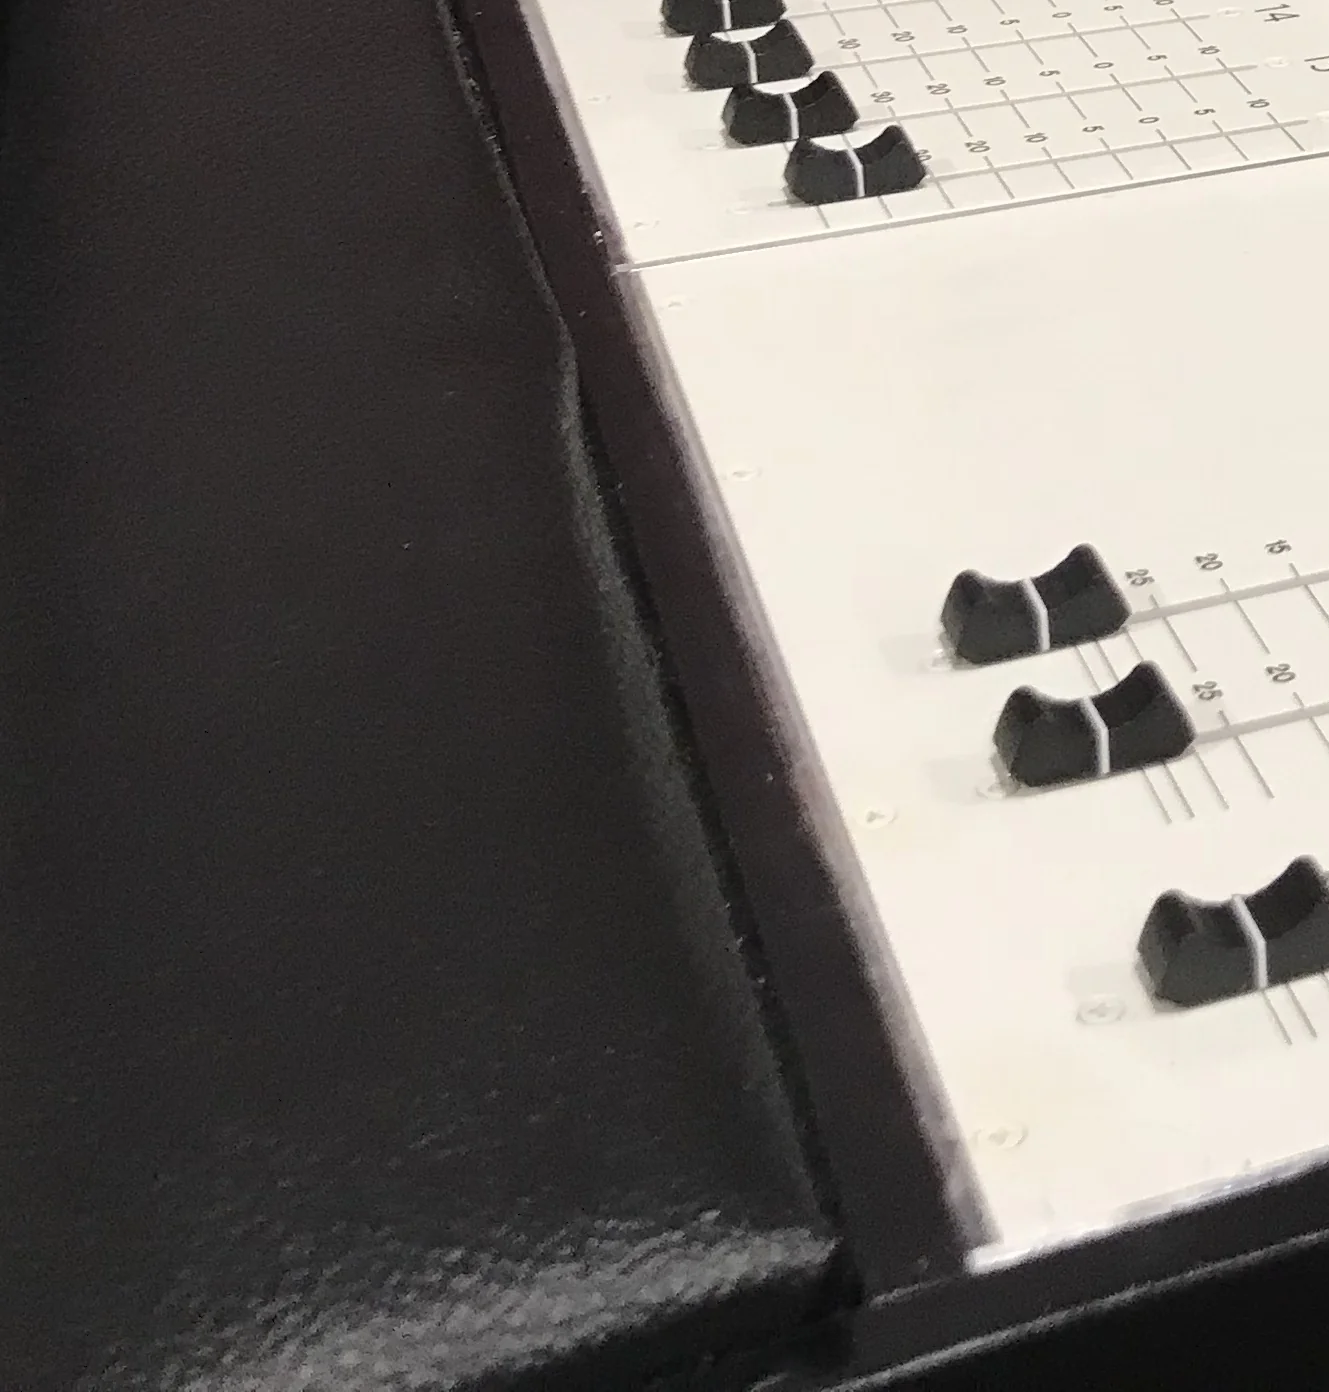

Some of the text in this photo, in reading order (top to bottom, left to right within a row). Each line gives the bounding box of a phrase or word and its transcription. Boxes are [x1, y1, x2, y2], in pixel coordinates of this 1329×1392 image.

[1254, 3, 1300, 23] 14
[964, 98, 1271, 154] 20 10 5 0 5 10
[1124, 568, 1155, 586] 25
[1194, 553, 1223, 571] 20
[1264, 539, 1291, 554] 15
[1192, 680, 1223, 701] 25
[1264, 663, 1296, 684] 20
